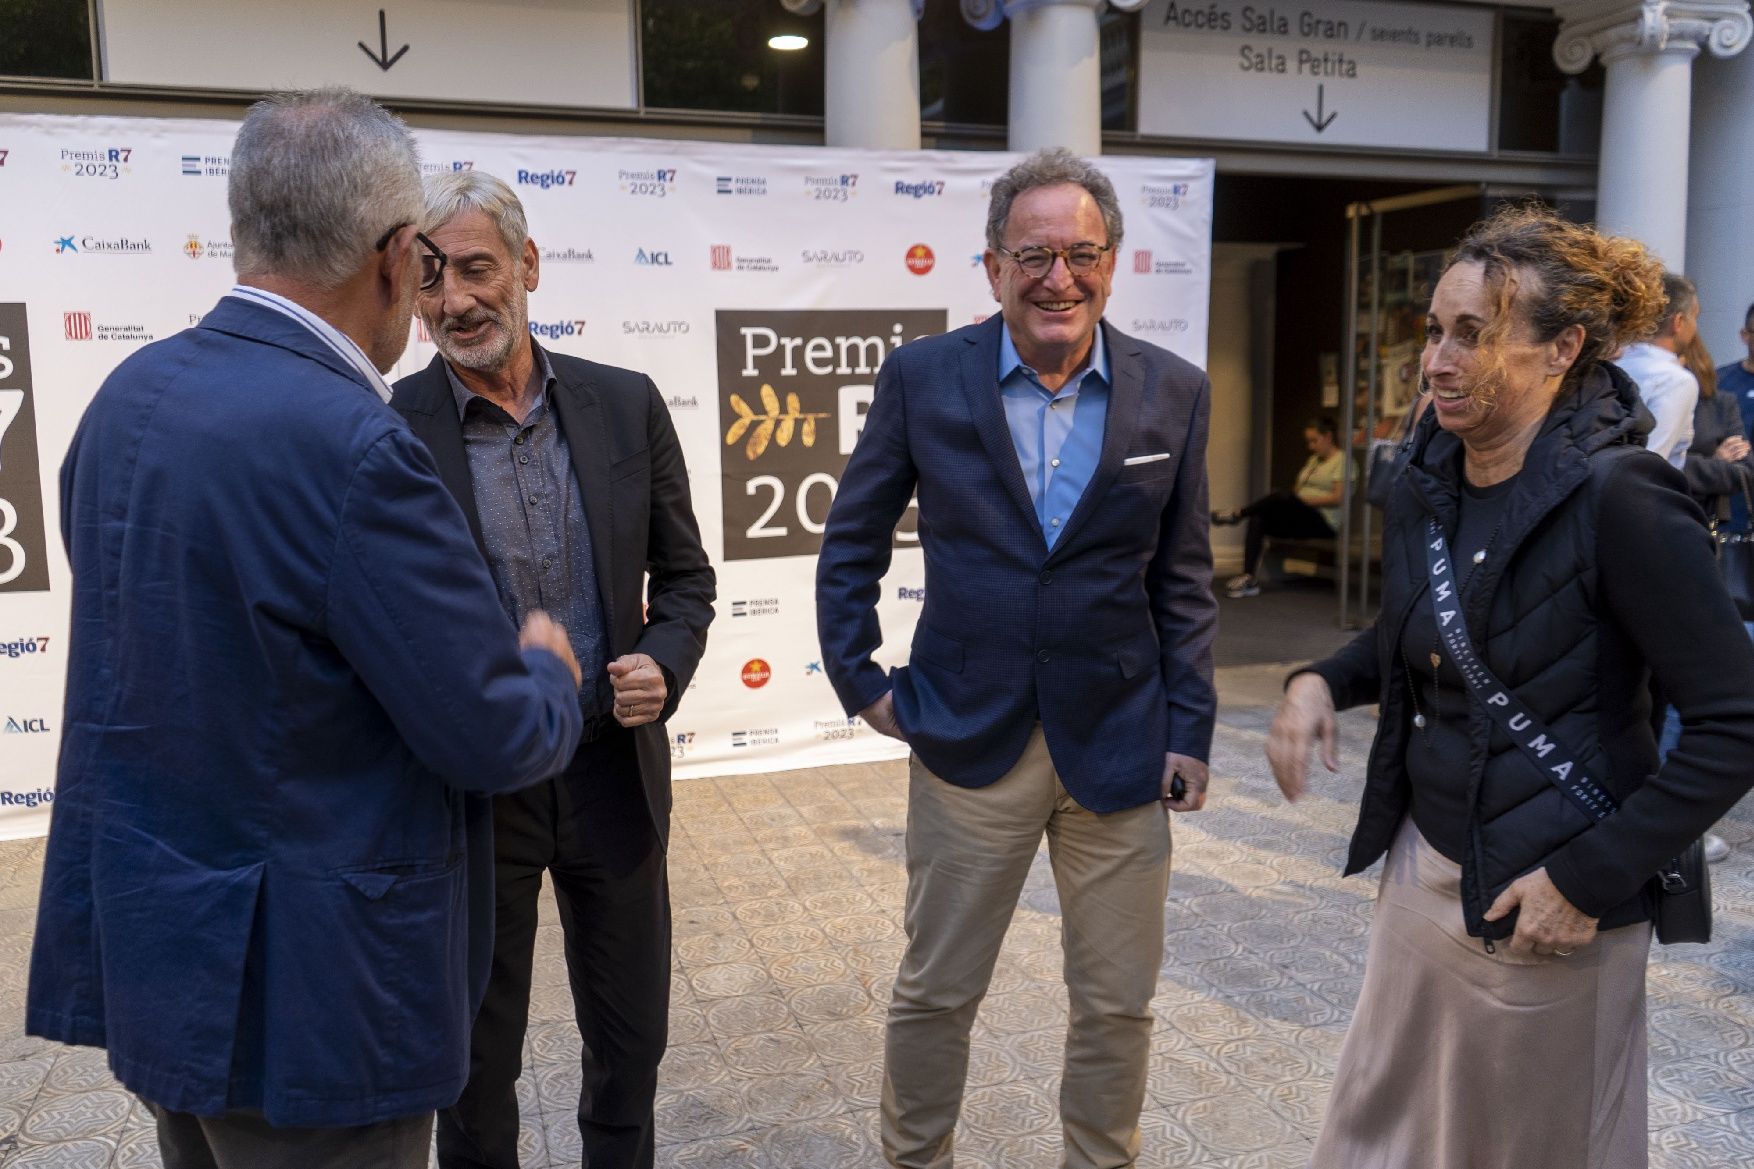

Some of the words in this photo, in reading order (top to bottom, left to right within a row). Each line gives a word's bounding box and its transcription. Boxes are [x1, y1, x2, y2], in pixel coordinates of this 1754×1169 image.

[1163, 2, 1232, 31] Accés
[1241, 7, 1289, 35] Sala
[1300, 12, 1349, 41] Gran
[1240, 46, 1287, 73] Sala
[1298, 51, 1358, 79] Petita
[61, 148, 105, 161] Premis
[107, 147, 132, 162] R7
[204, 156, 230, 166] PREN
[74, 163, 119, 179] 2023
[517, 169, 577, 188] Regió7
[618, 170, 655, 181] Premis
[657, 169, 676, 182] R7
[840, 174, 859, 187] R7
[630, 182, 666, 197] 2023
[814, 188, 848, 202] 2023
[895, 180, 945, 198] Regió7
[81, 236, 151, 252] CaixaBank
[650, 251, 673, 265] ICL
[801, 250, 864, 264] SARAUTO
[528, 320, 586, 339] Regió7
[622, 320, 690, 334] SARAUTO
[98, 333, 109, 341] de
[740, 323, 932, 376] Premi
[1430, 537, 1457, 627] PUMA
[898, 587, 926, 602] Reg
[0, 636, 50, 658] egió7
[23, 718, 51, 734] ICL
[677, 733, 696, 744] R7
[823, 728, 855, 741] 2023
[1487, 692, 1574, 781] PUMA
[671, 746, 685, 758] 23
[0, 789, 55, 808] Regió
